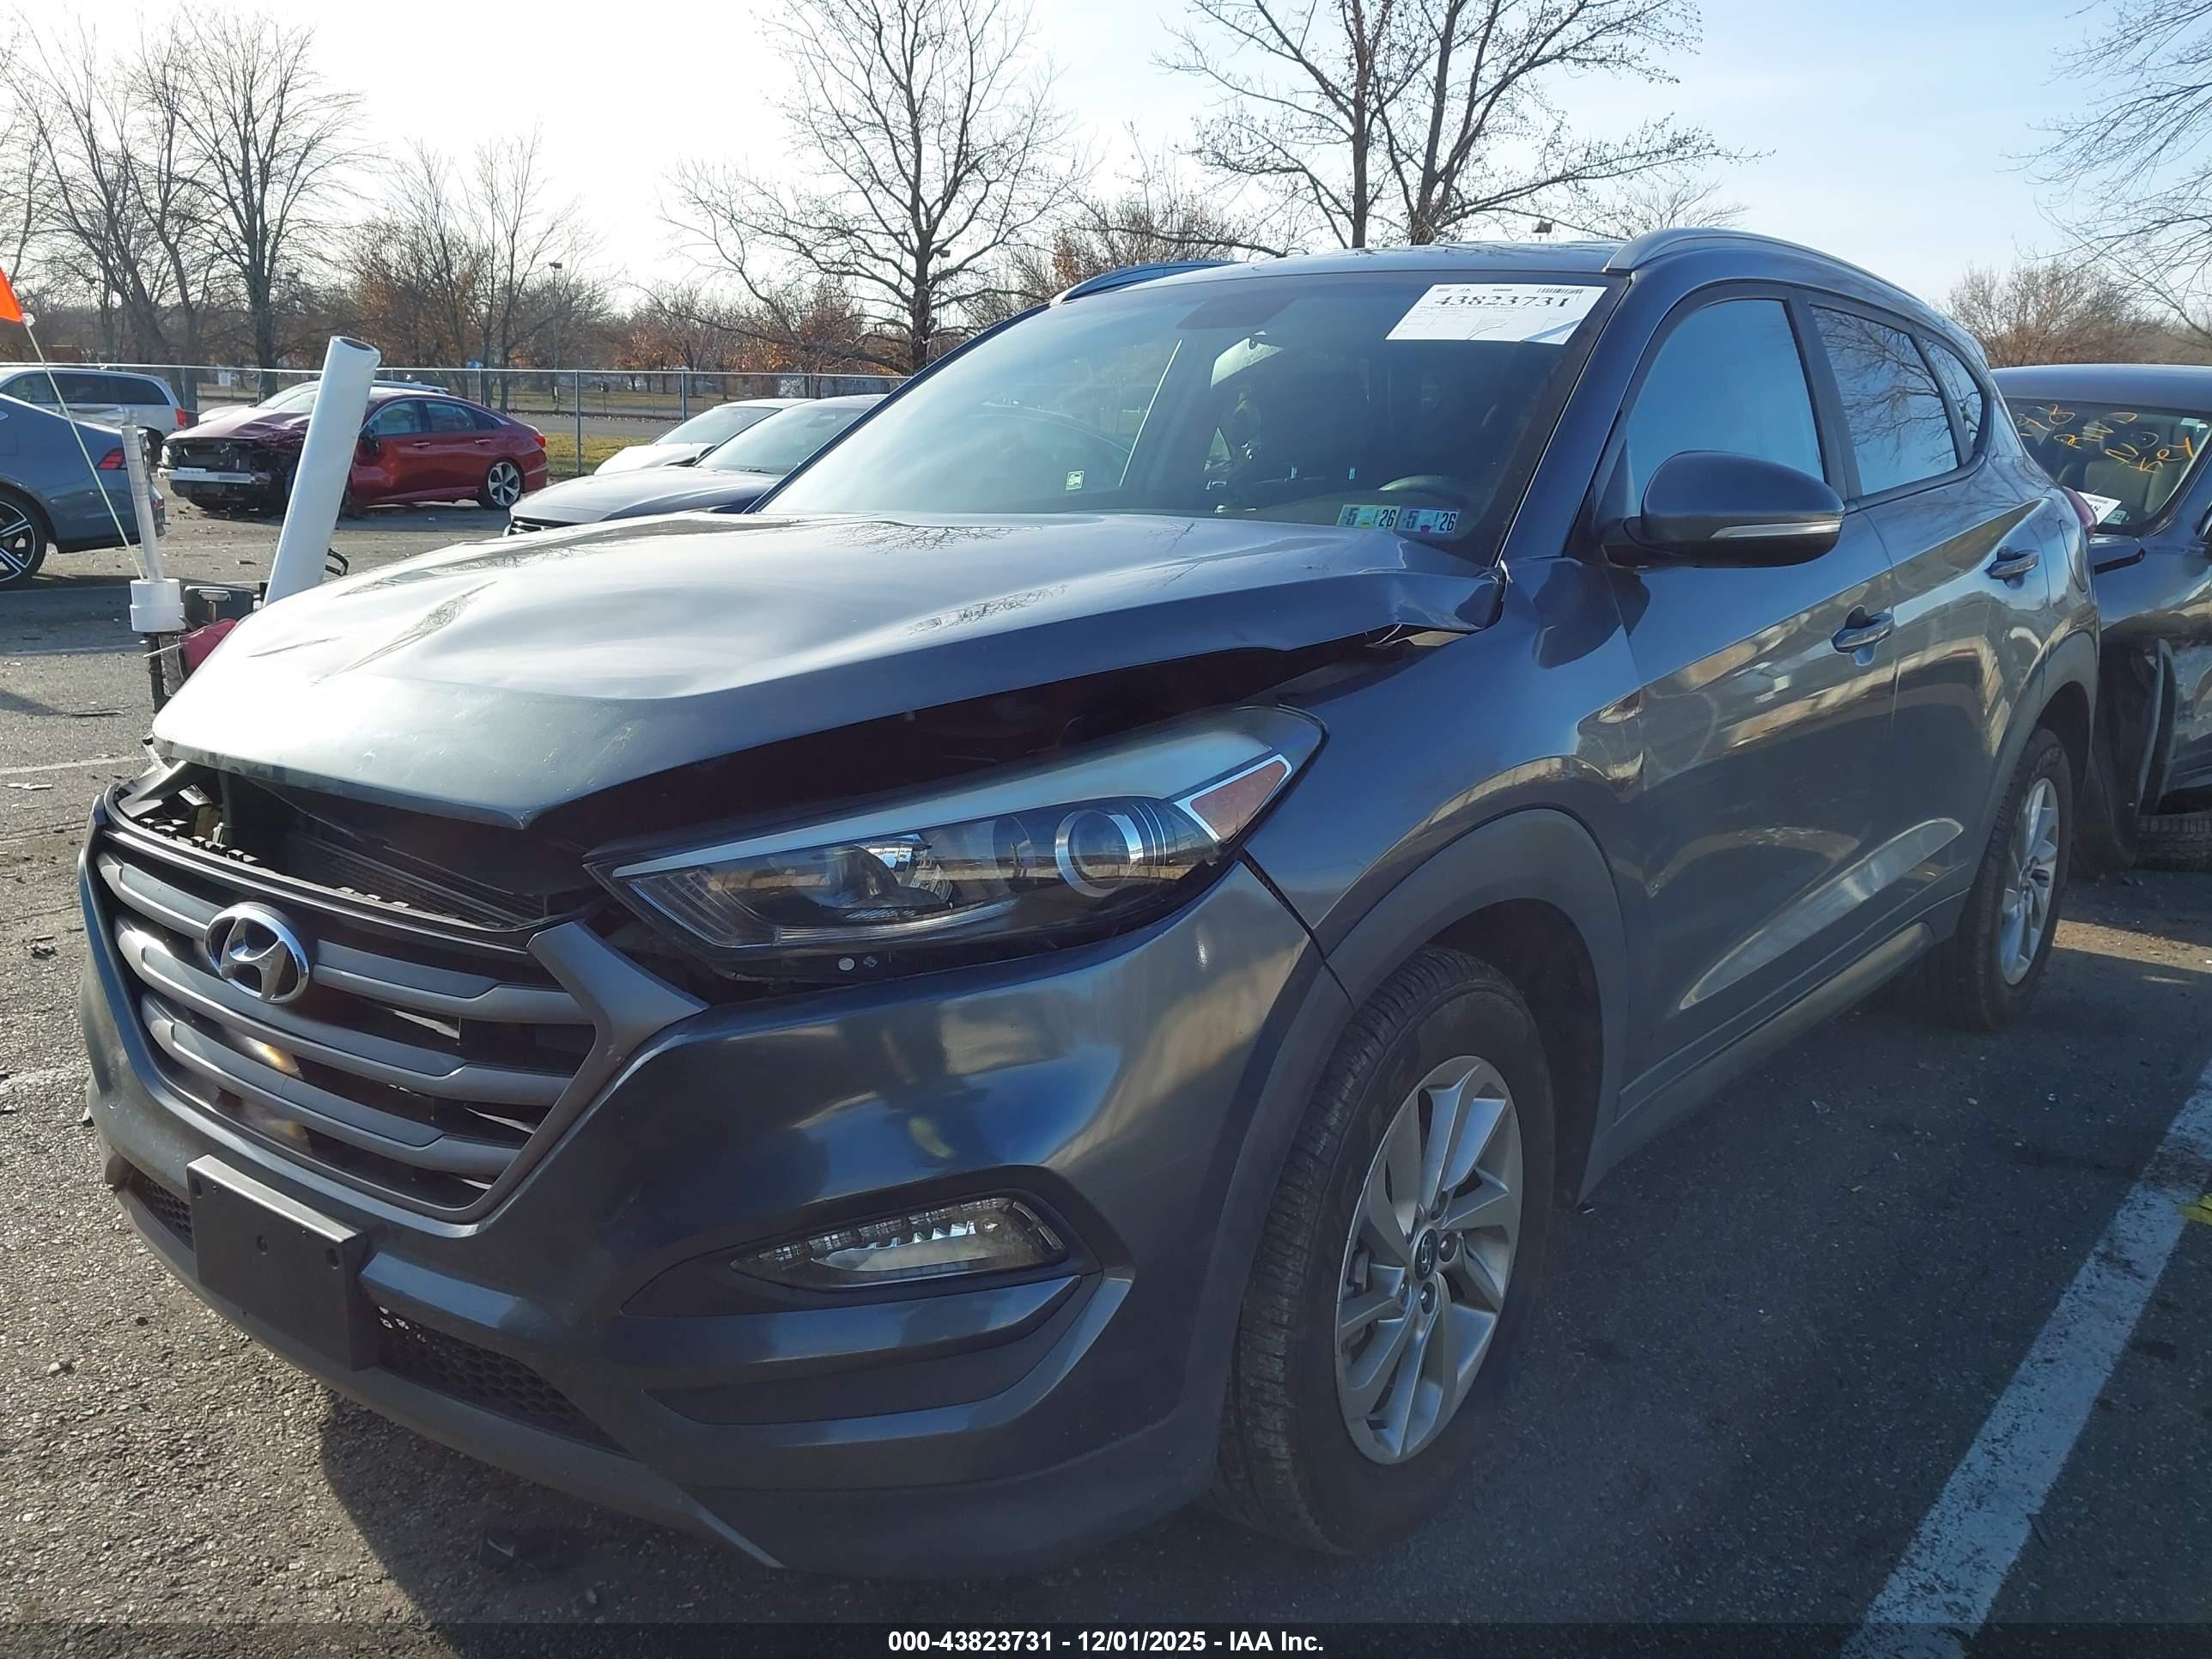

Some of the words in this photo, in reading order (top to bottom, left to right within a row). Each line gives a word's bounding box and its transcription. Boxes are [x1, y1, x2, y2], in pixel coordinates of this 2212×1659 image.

[1434, 295, 1570, 307] 43823731
[1378, 508, 1397, 527] 26
[1439, 513, 1457, 531] 26
